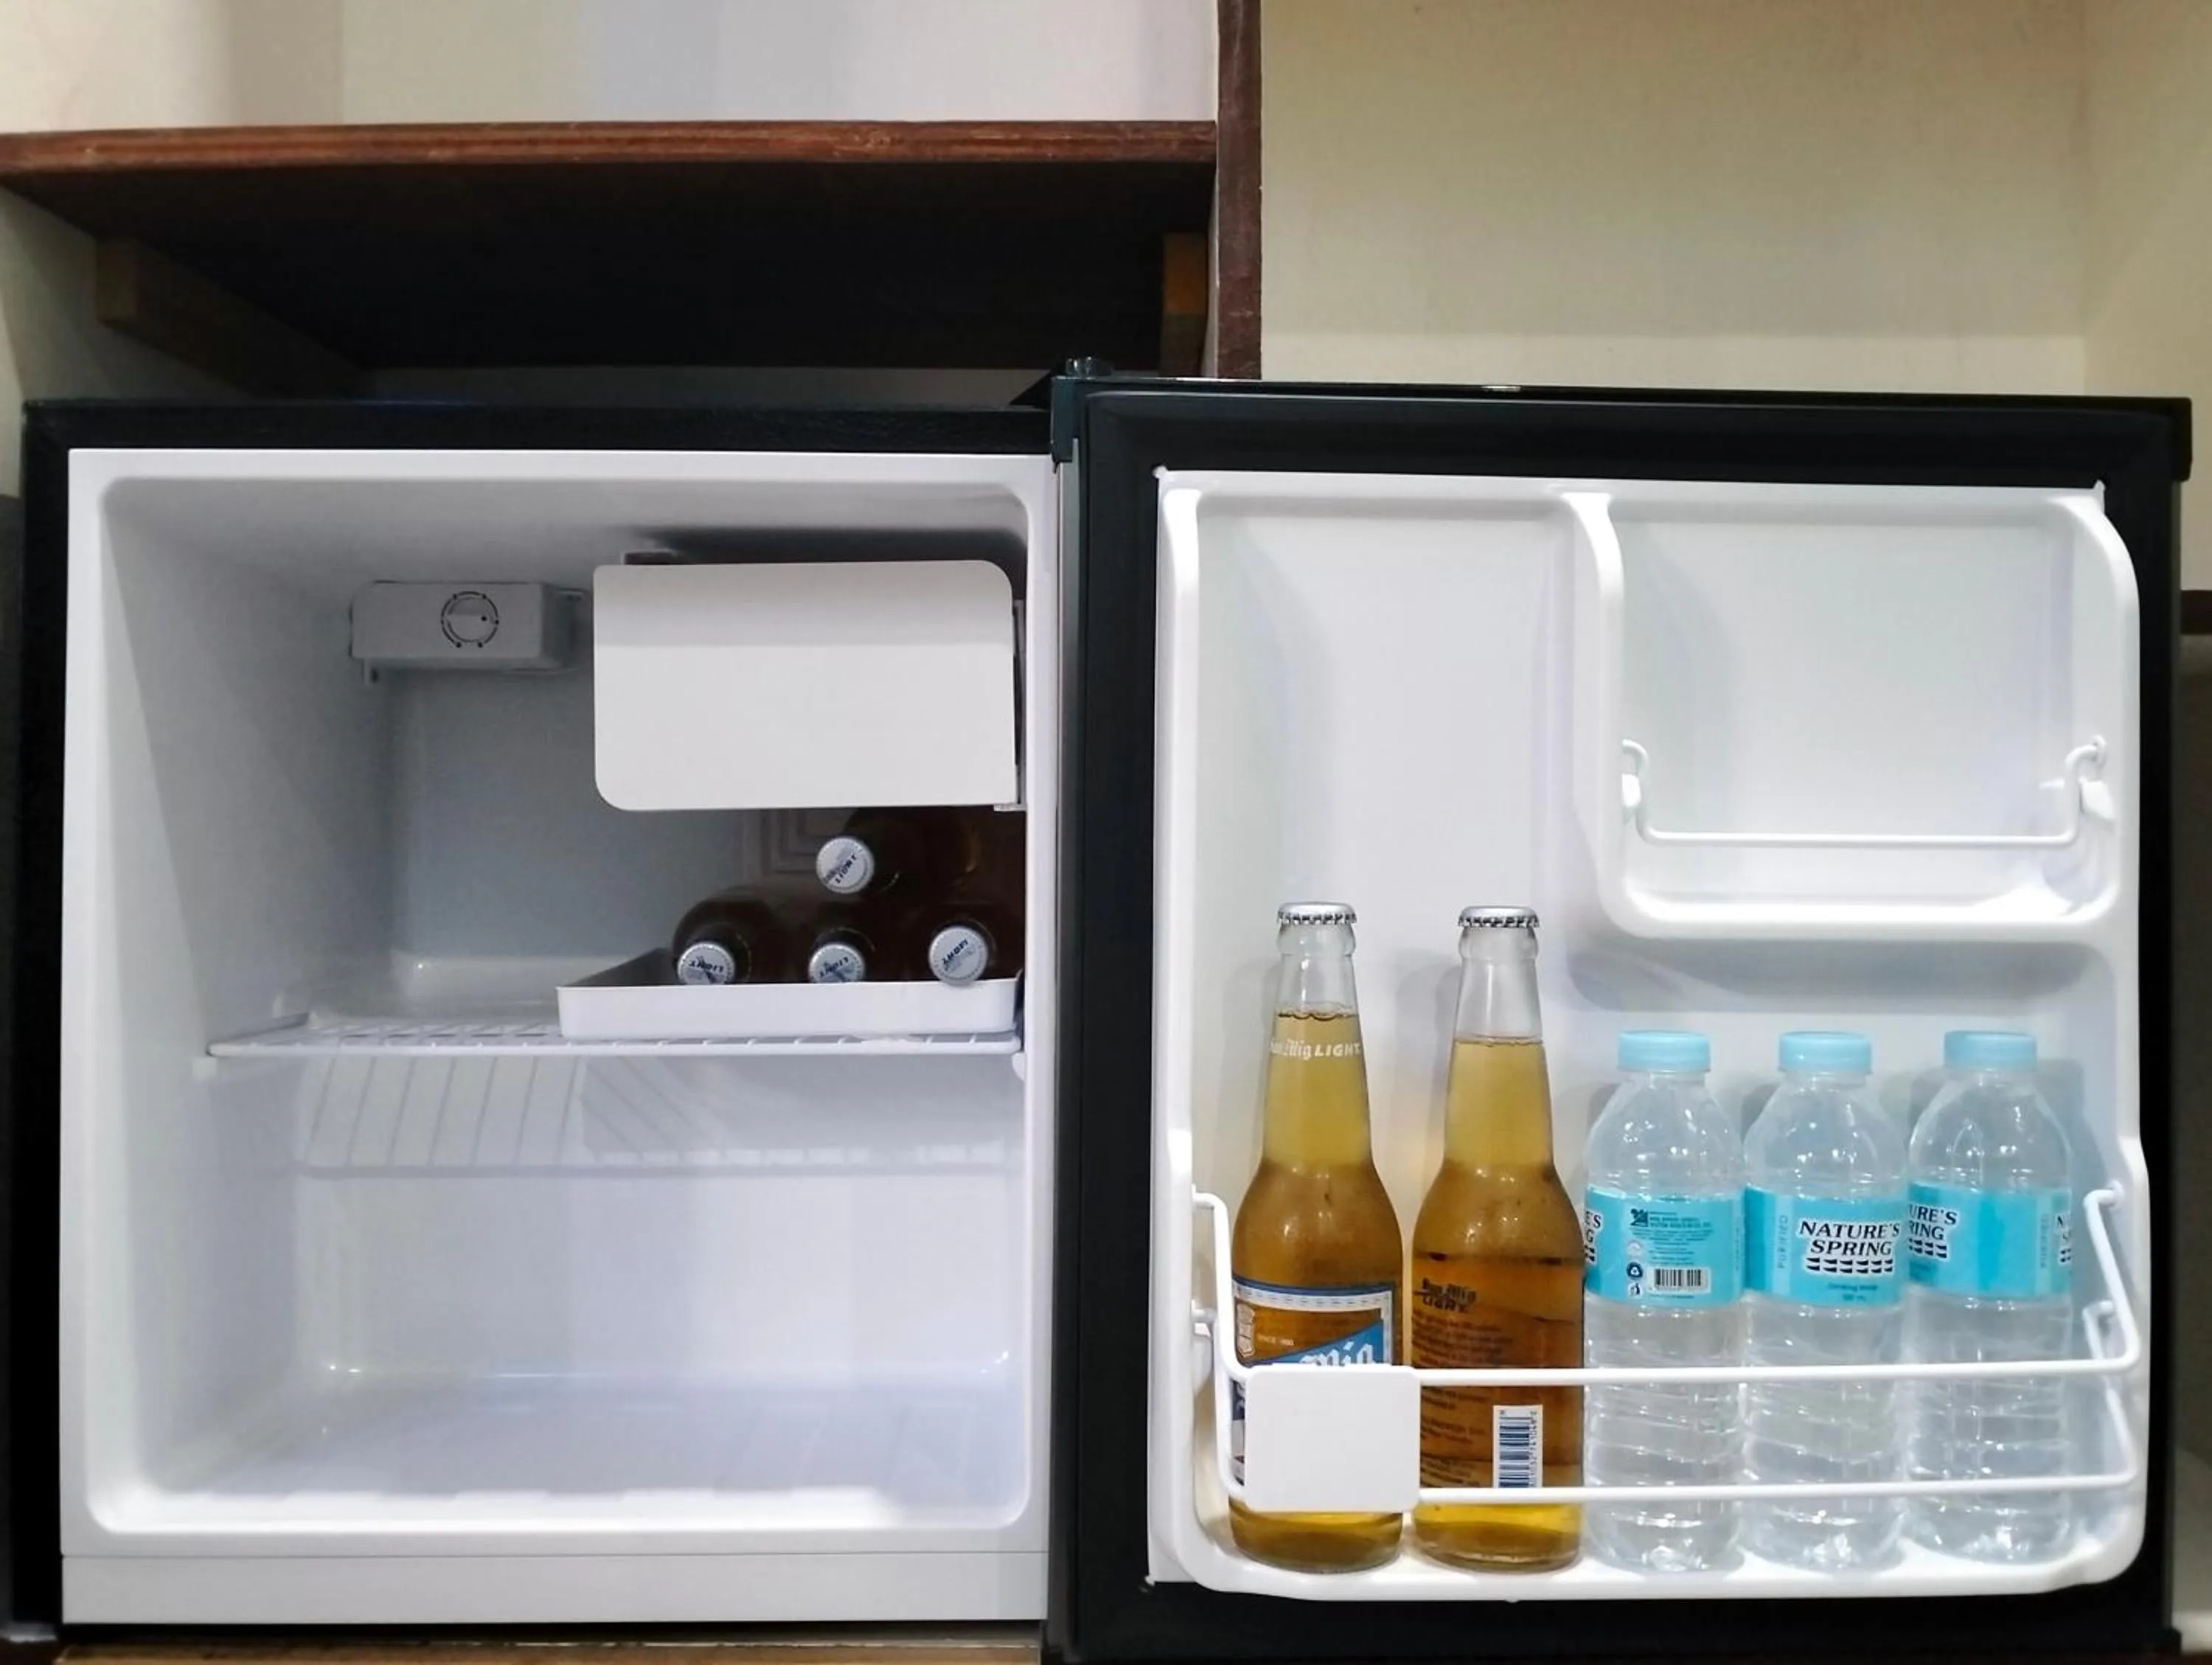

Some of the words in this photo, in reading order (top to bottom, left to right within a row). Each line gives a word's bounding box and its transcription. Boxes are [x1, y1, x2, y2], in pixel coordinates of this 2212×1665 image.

[1314, 1040, 1361, 1057] LIGHT
[1908, 1203, 1958, 1226] URE'S
[1799, 1220, 1900, 1240] NATURE'S
[1908, 1220, 1944, 1240] RING
[1777, 1214, 1789, 1270] PURIFIED
[1810, 1239, 1893, 1256] SPRING
